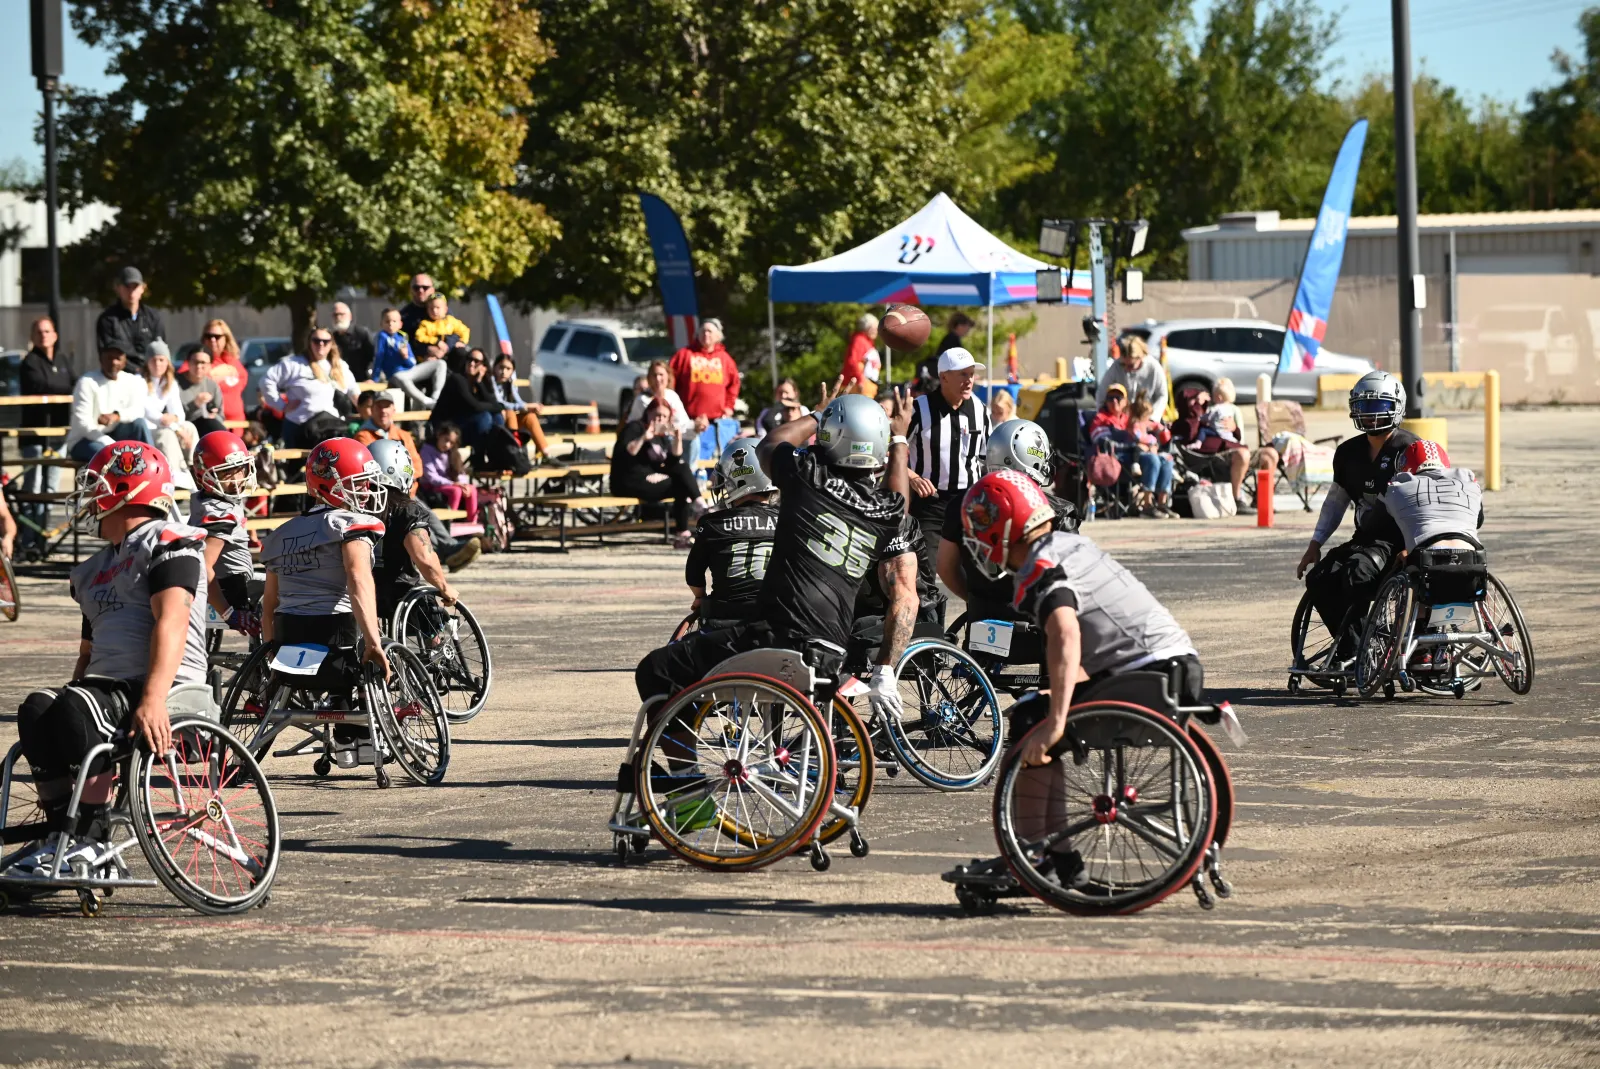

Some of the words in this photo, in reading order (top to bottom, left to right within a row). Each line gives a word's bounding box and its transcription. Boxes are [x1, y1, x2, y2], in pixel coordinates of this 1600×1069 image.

[1416, 476, 1471, 509] 13
[723, 516, 778, 531] OUTLA
[806, 512, 877, 579] 35
[1445, 607, 1455, 620] 3
[987, 626, 996, 644] 3
[296, 650, 306, 667] 1
